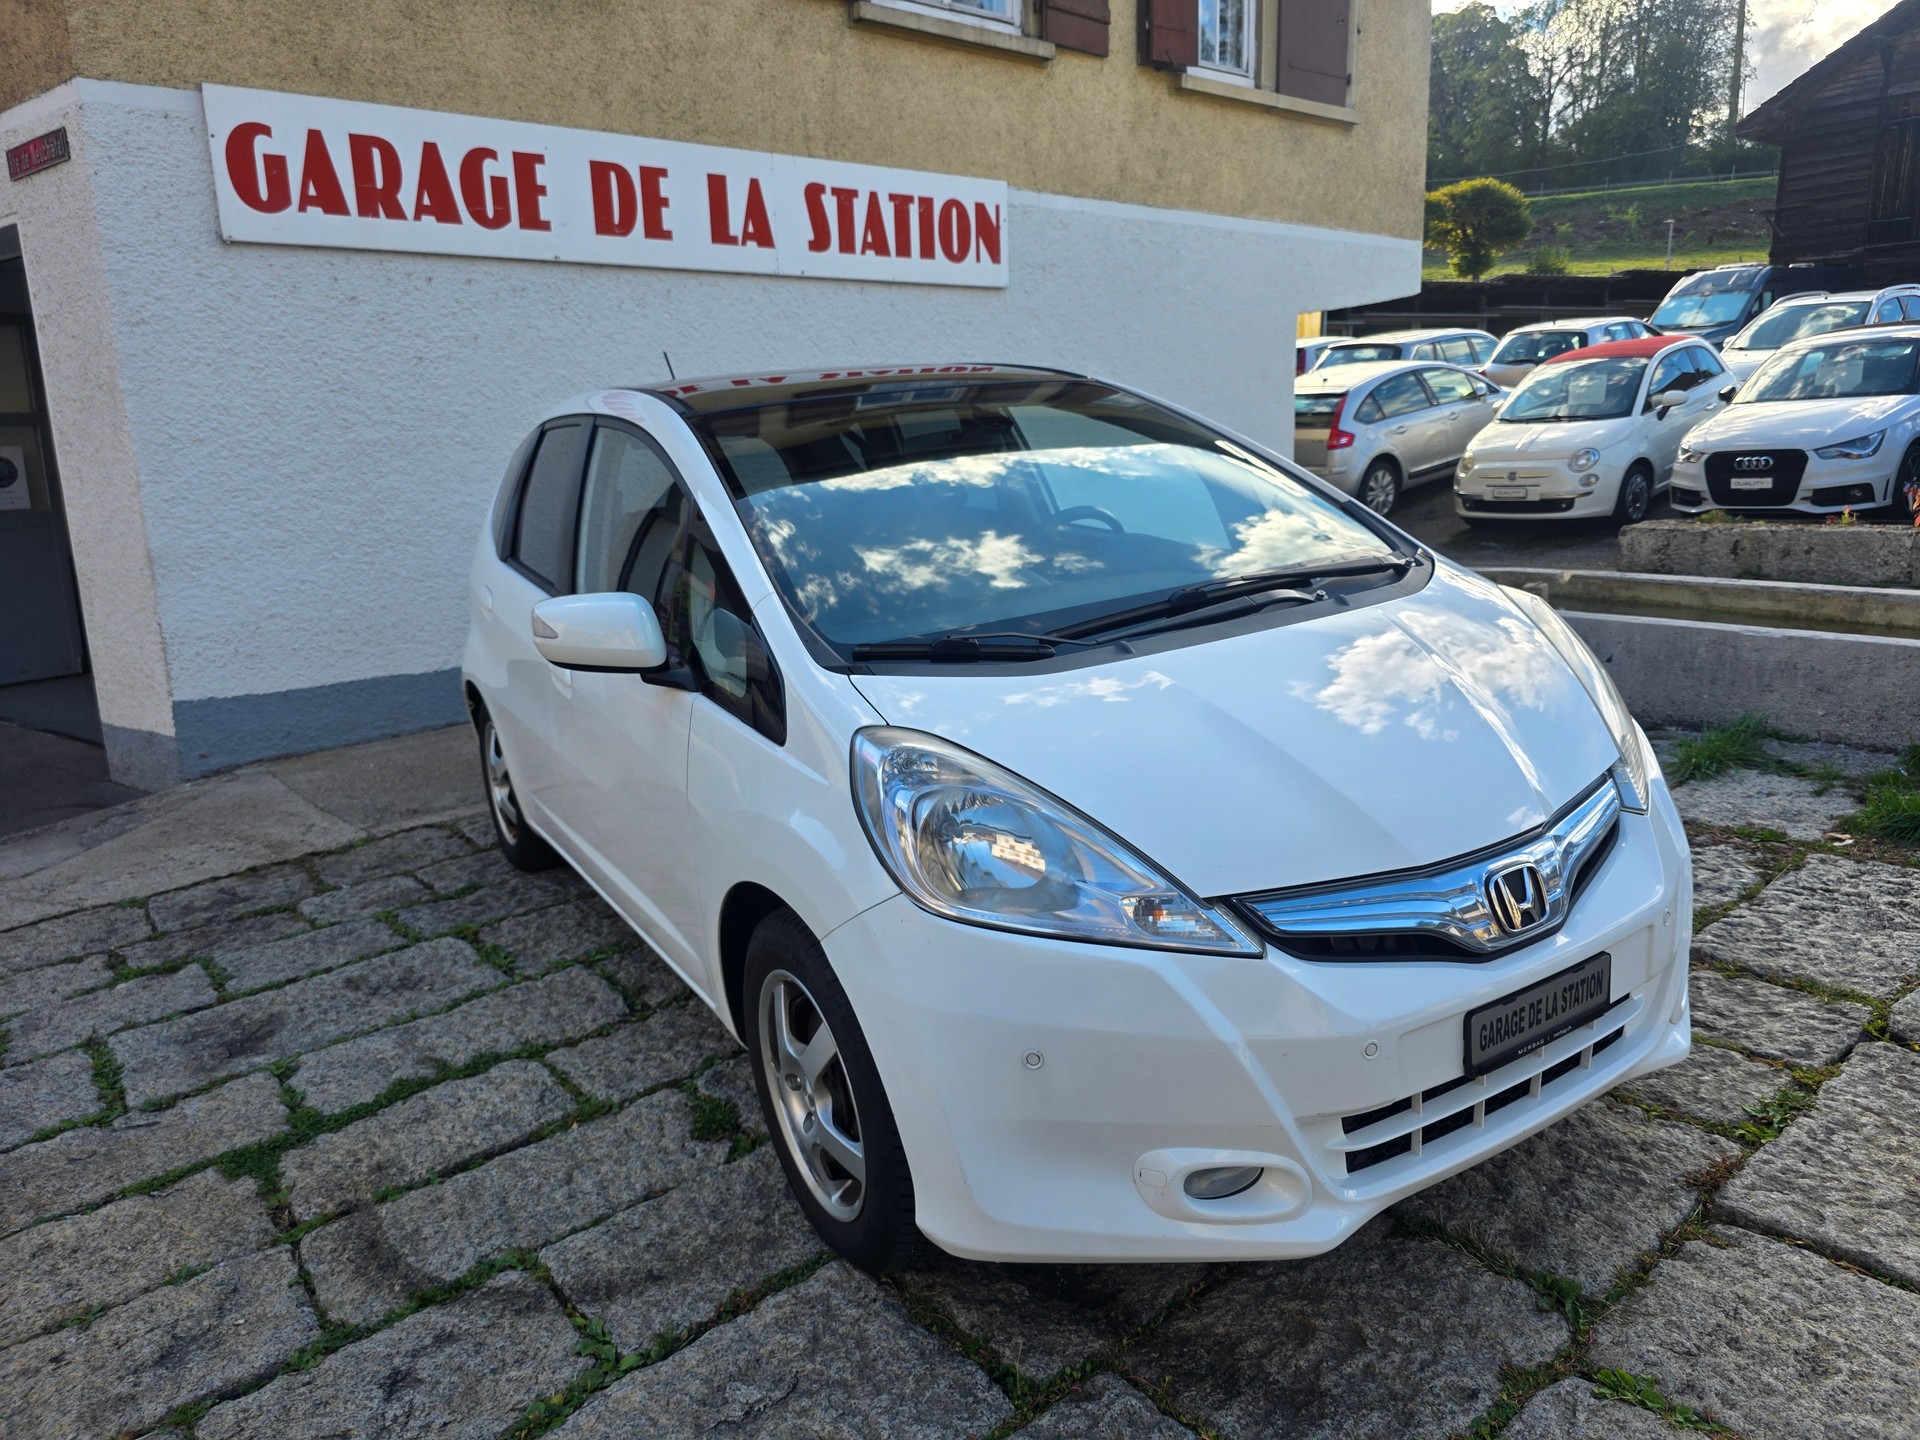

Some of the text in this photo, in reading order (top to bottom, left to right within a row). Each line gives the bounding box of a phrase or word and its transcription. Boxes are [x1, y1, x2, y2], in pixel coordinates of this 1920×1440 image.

[225, 121, 1002, 265] GARAGE DE LA STATION
[1479, 968, 1604, 1052] GARAGE DE LA STATION
[1517, 1038, 1545, 1055] MERBAG
